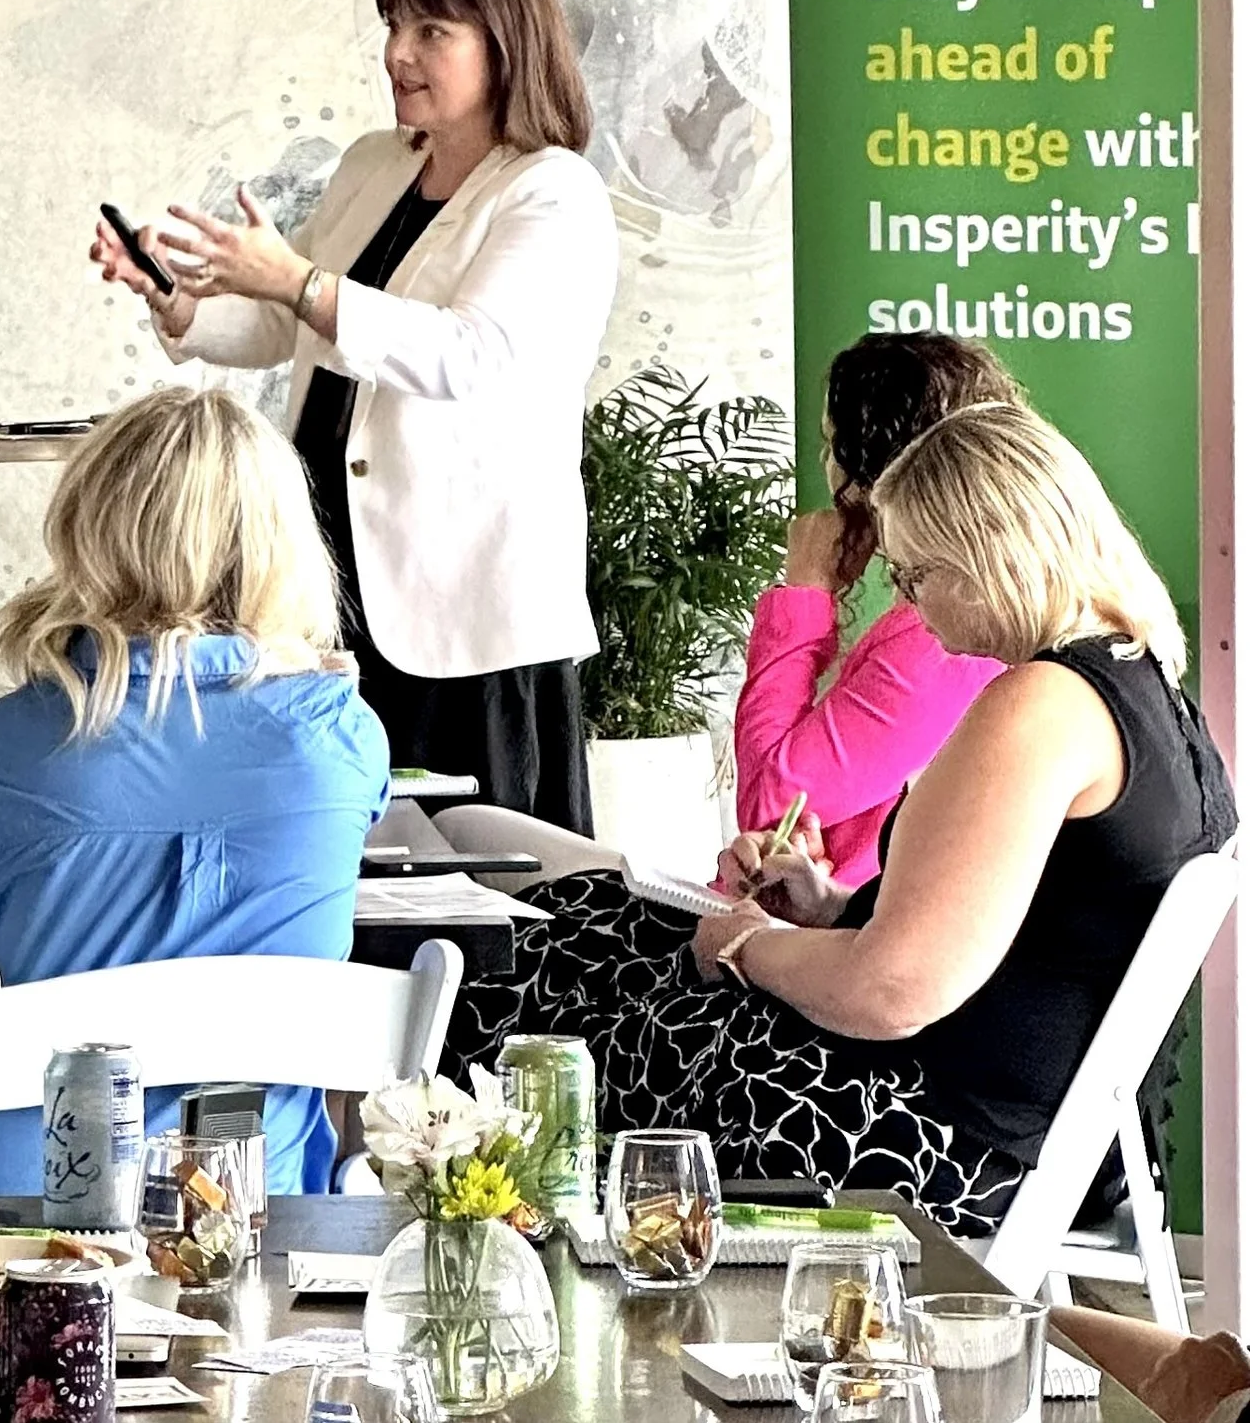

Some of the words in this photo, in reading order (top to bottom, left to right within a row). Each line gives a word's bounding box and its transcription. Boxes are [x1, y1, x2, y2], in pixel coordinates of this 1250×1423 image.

[865, 26, 1038, 81] ahead
[1055, 24, 1115, 81] of
[866, 112, 1070, 182] change
[869, 197, 1169, 269] Insperity’s
[867, 282, 1132, 341] solutions
